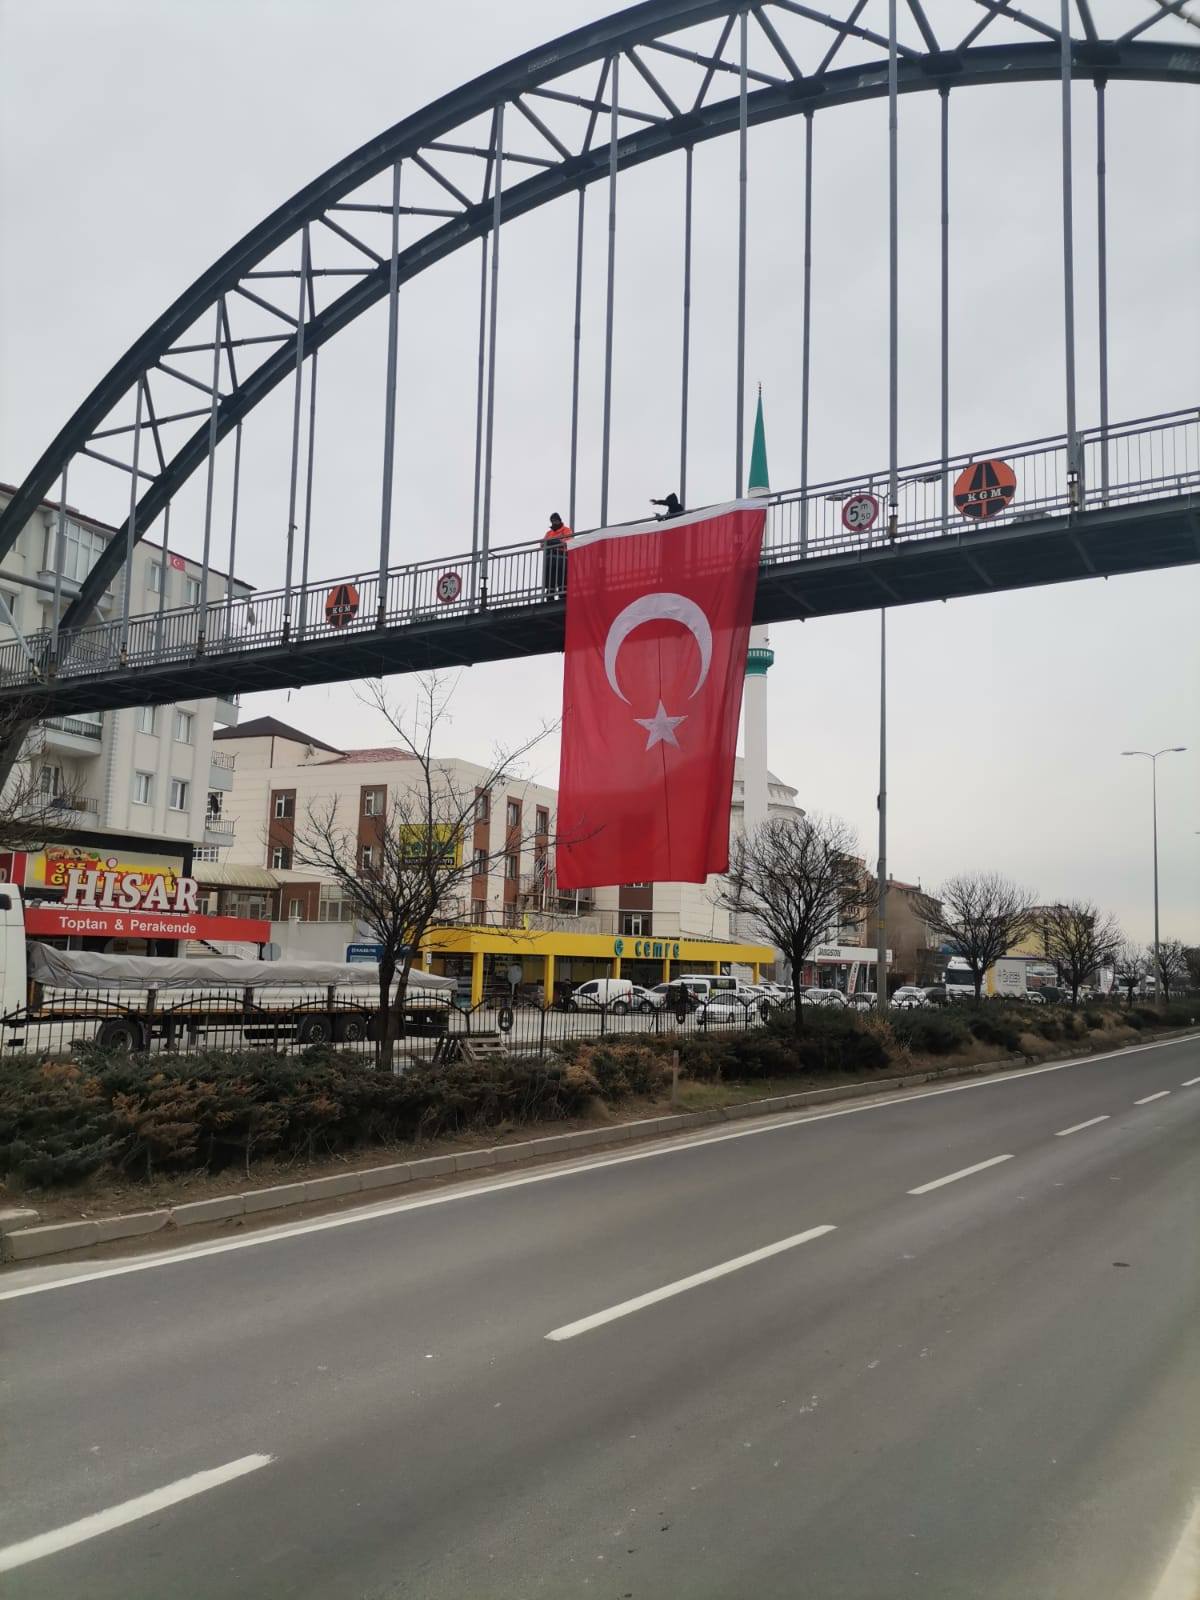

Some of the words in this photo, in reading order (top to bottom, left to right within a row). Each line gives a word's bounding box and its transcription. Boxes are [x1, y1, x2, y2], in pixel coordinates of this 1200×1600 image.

[967, 488, 1002, 502] KGM
[850, 505, 859, 523] 5
[59, 916, 108, 933] Toptan
[114, 920, 124, 931] &
[130, 920, 197, 934] Perakende
